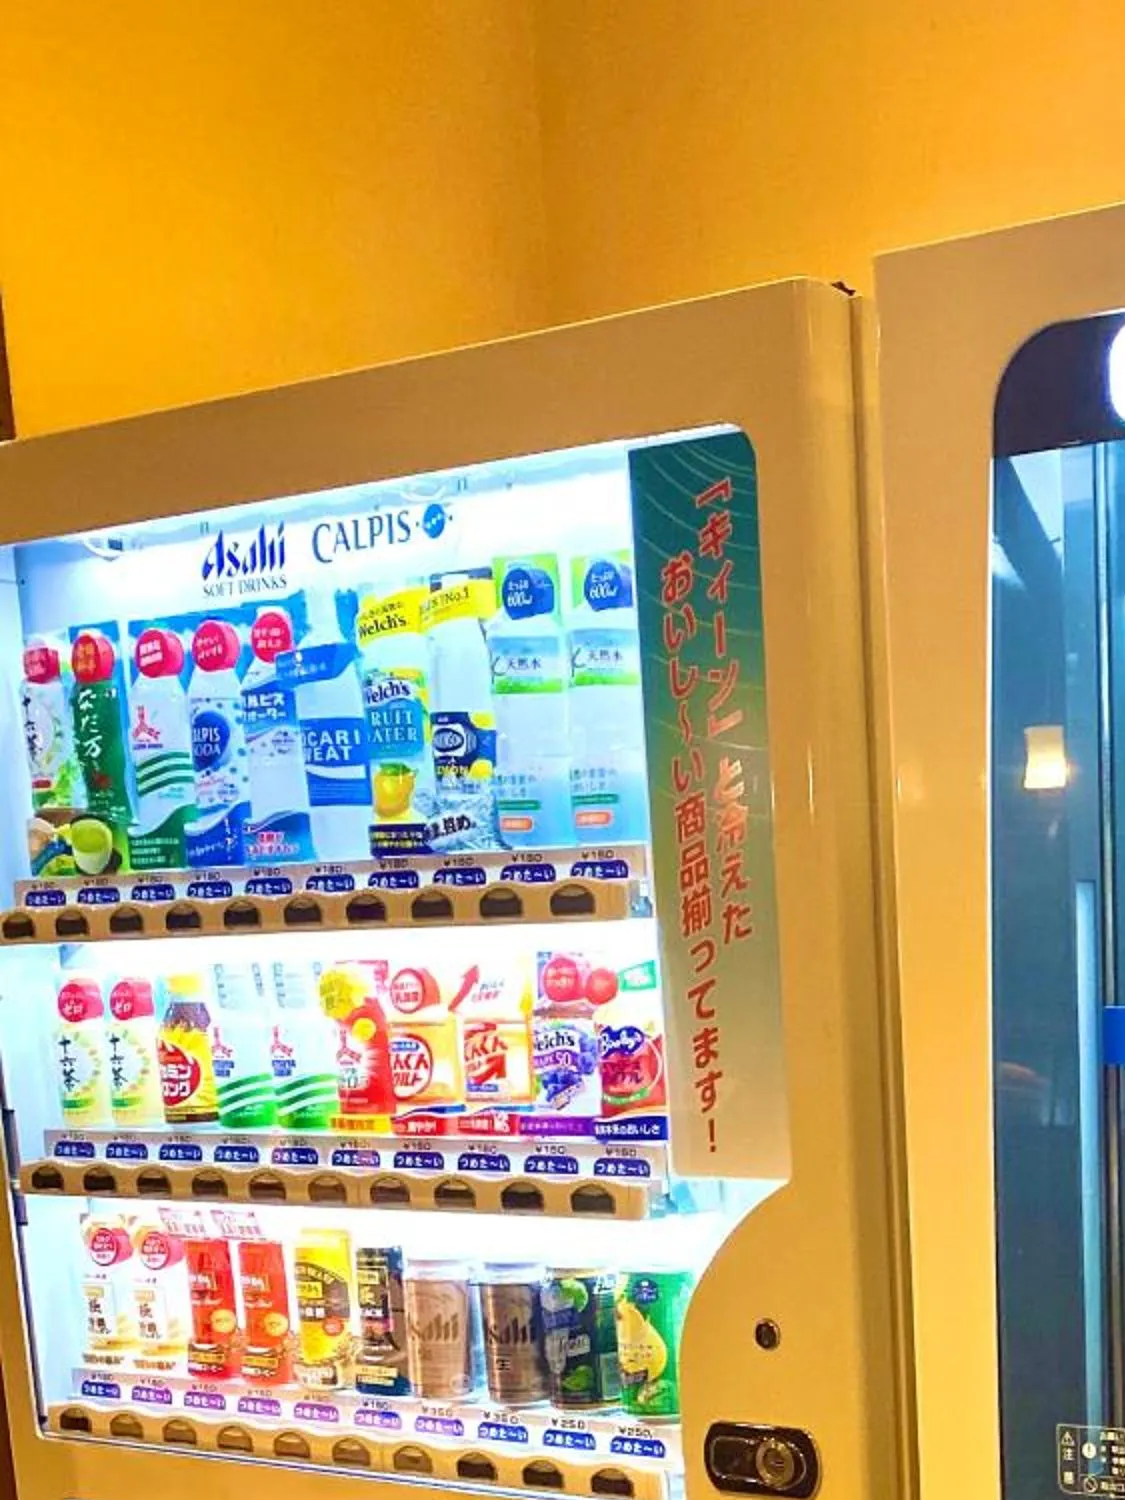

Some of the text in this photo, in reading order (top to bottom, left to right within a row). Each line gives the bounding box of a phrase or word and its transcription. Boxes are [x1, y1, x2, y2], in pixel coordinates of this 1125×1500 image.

[202, 520, 285, 580] Asahi
[311, 510, 411, 563] CALPIS
[203, 574, 287, 598] SOFT DRINKS
[359, 613, 407, 640] Welch's
[77, 688, 103, 757] なだ万
[370, 711, 413, 726] RUIT
[367, 728, 417, 743] ATER
